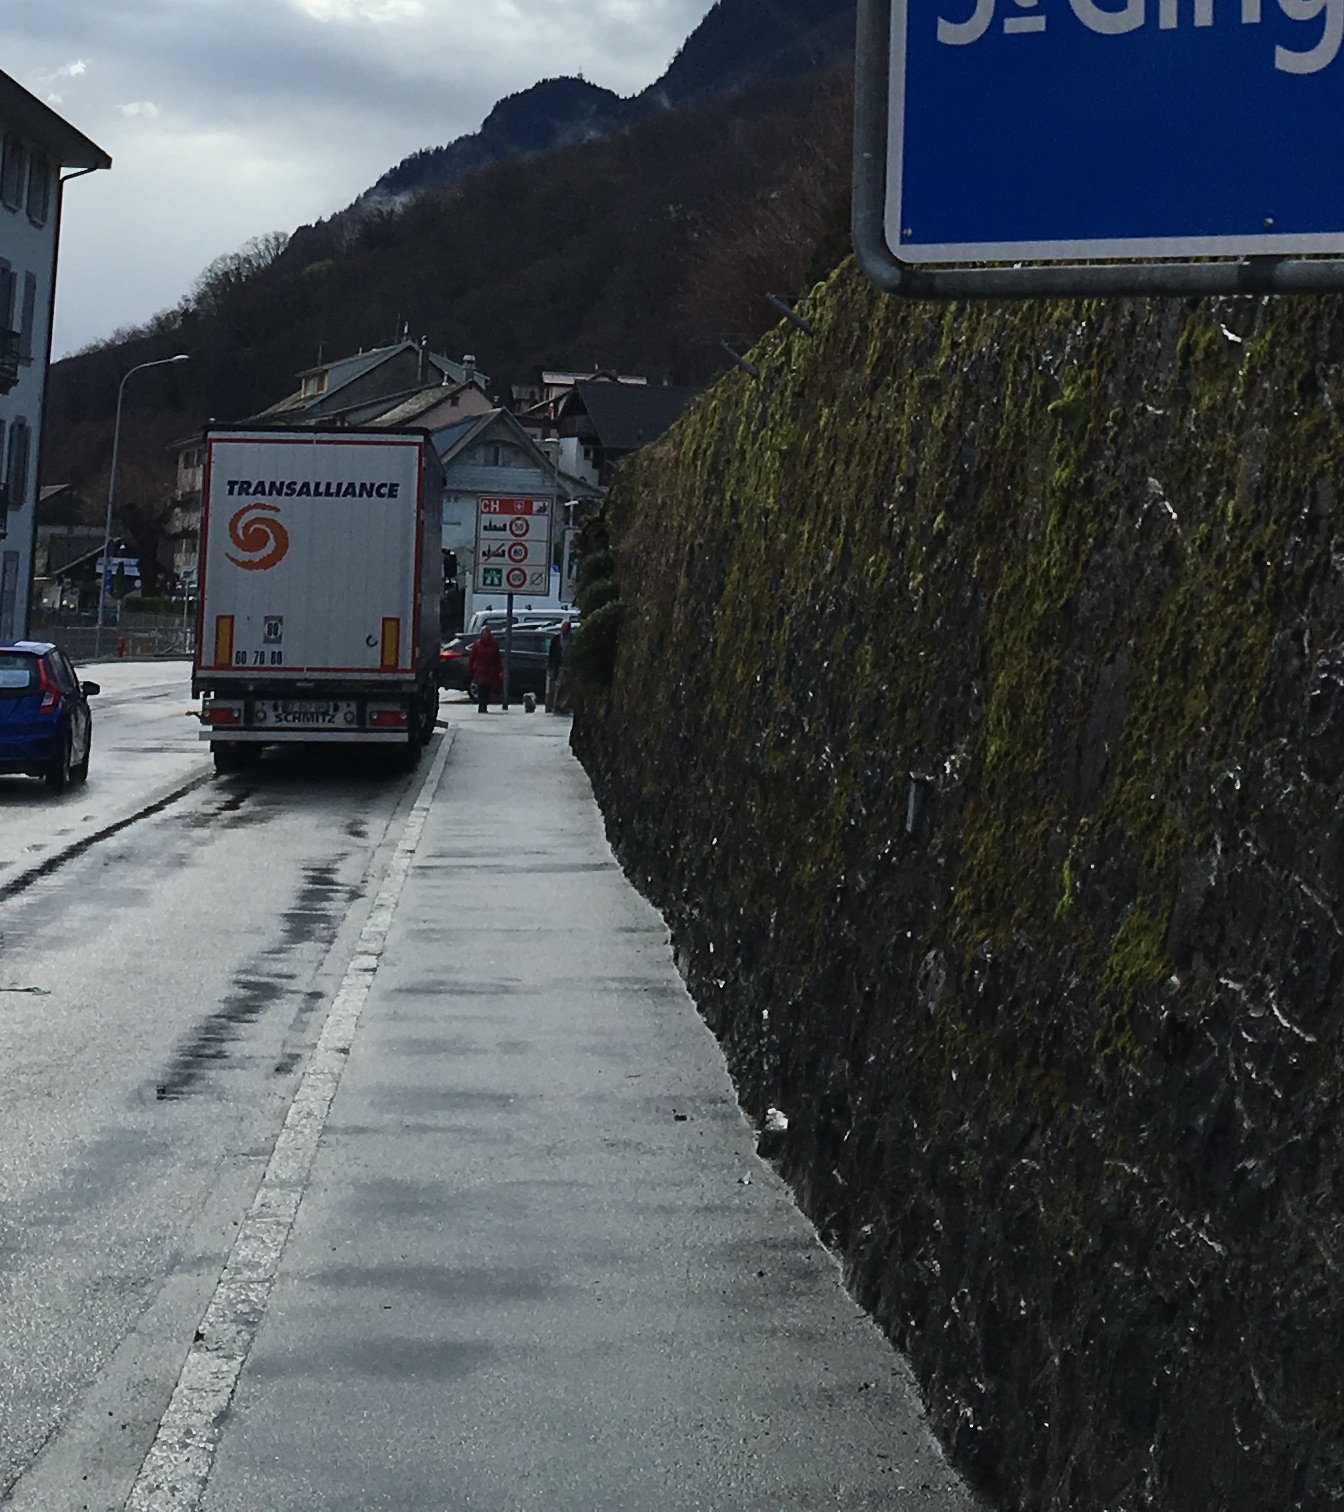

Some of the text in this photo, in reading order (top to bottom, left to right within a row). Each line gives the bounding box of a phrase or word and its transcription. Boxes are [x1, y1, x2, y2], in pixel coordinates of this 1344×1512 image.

[226, 480, 400, 499] TRANSALLIANCE
[481, 500, 500, 513] CH
[514, 522, 524, 532] 50
[235, 650, 283, 665] 60 70 80
[274, 711, 336, 724] SCHMITZ
